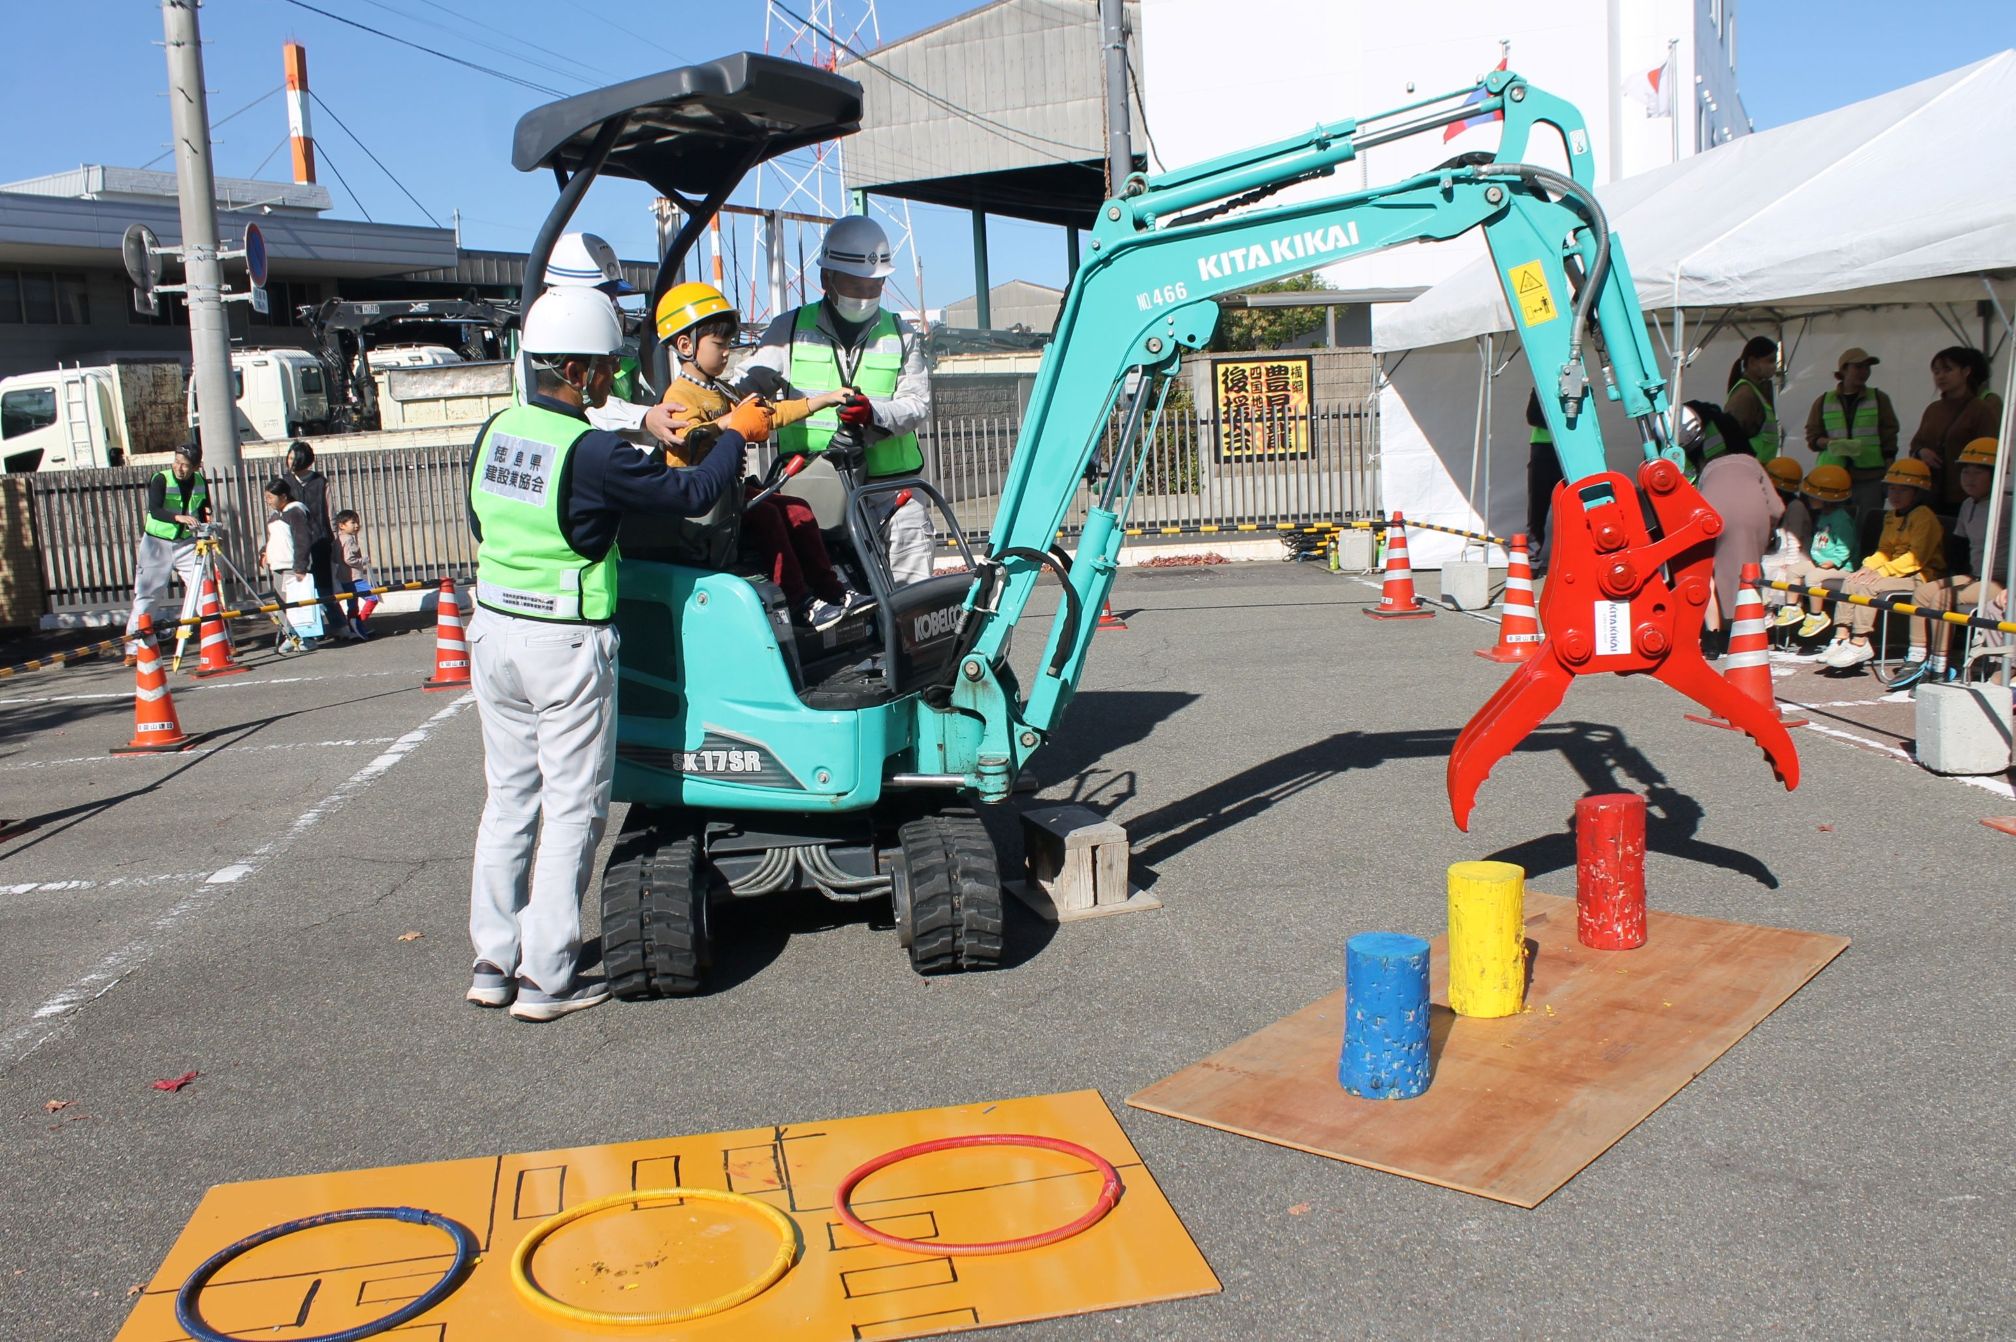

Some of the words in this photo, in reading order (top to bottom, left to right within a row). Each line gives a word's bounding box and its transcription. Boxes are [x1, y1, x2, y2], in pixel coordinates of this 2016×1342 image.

[1197, 221, 1360, 282] KITAKIKAI
[493, 445, 542, 472] 徳島県
[484, 464, 545, 494] 建設業協会
[914, 603, 962, 642] KOBELCO
[1609, 603, 1618, 652] KITAKIKAI
